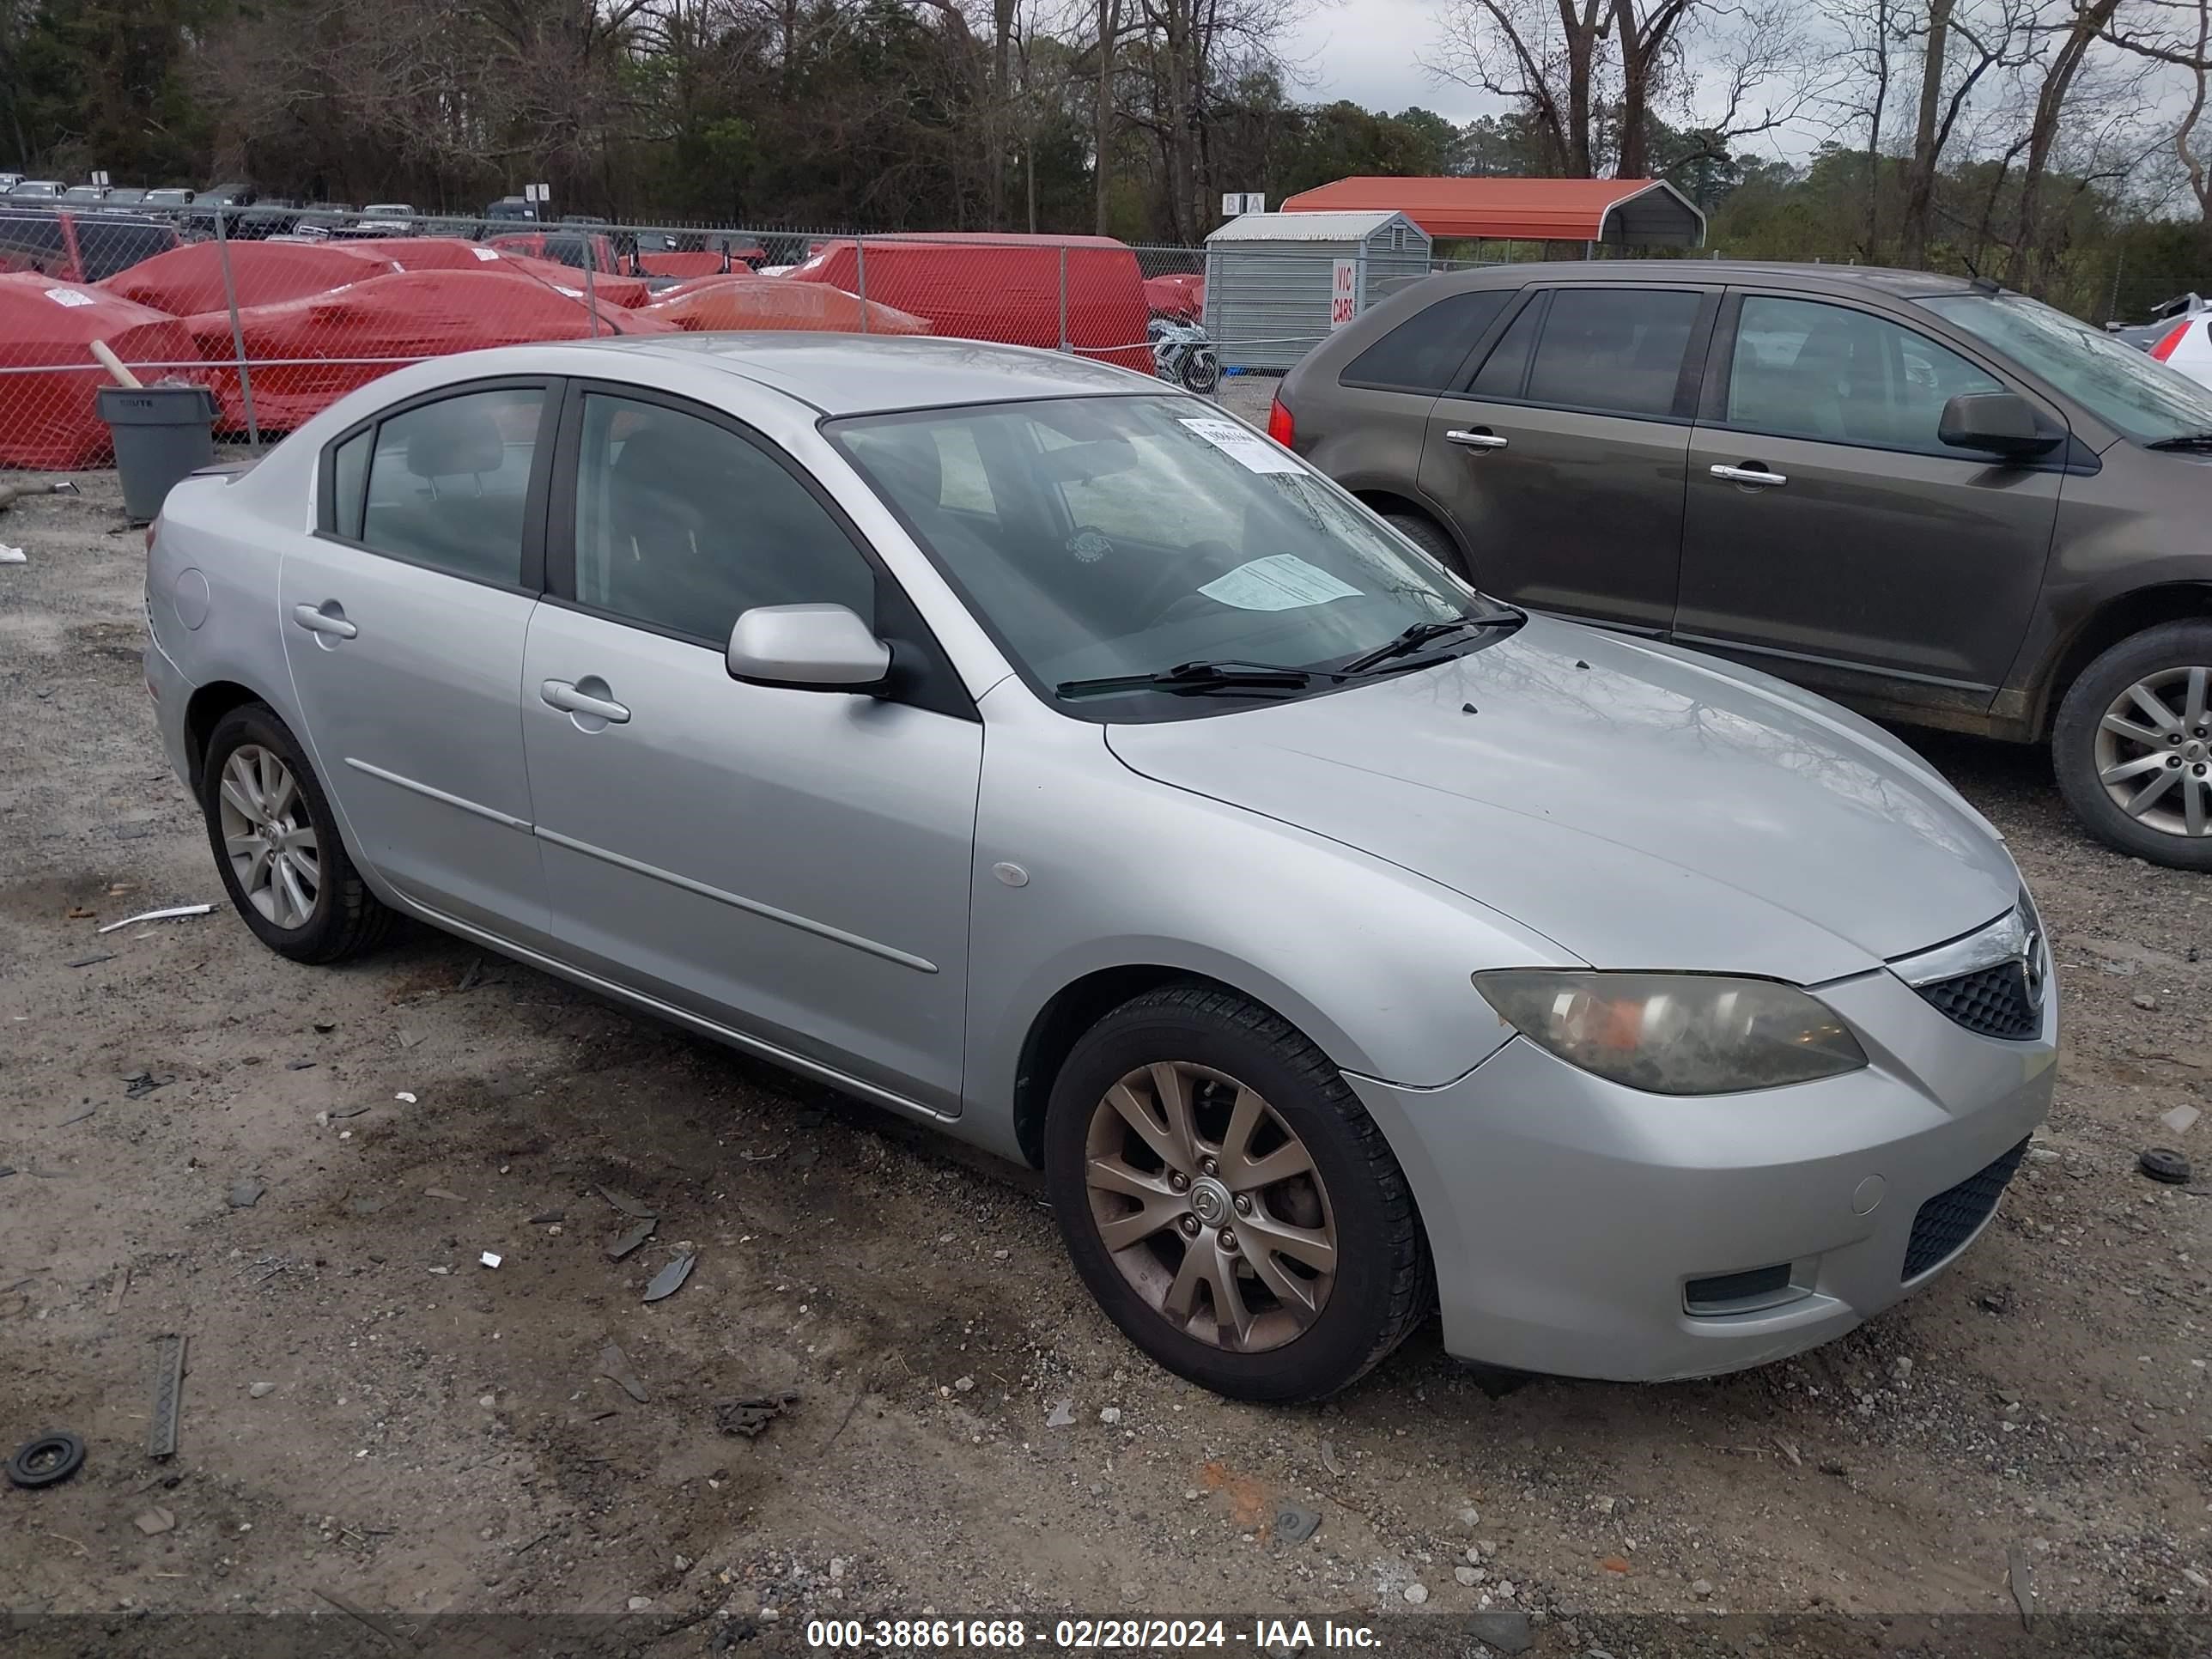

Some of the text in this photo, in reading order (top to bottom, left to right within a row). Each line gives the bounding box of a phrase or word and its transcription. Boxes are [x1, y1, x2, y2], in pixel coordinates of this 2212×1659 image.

[1226, 196, 1237, 212] B
[1249, 196, 1261, 212] A
[1338, 266, 1352, 291] VIC
[1333, 298, 1353, 323] CARS
